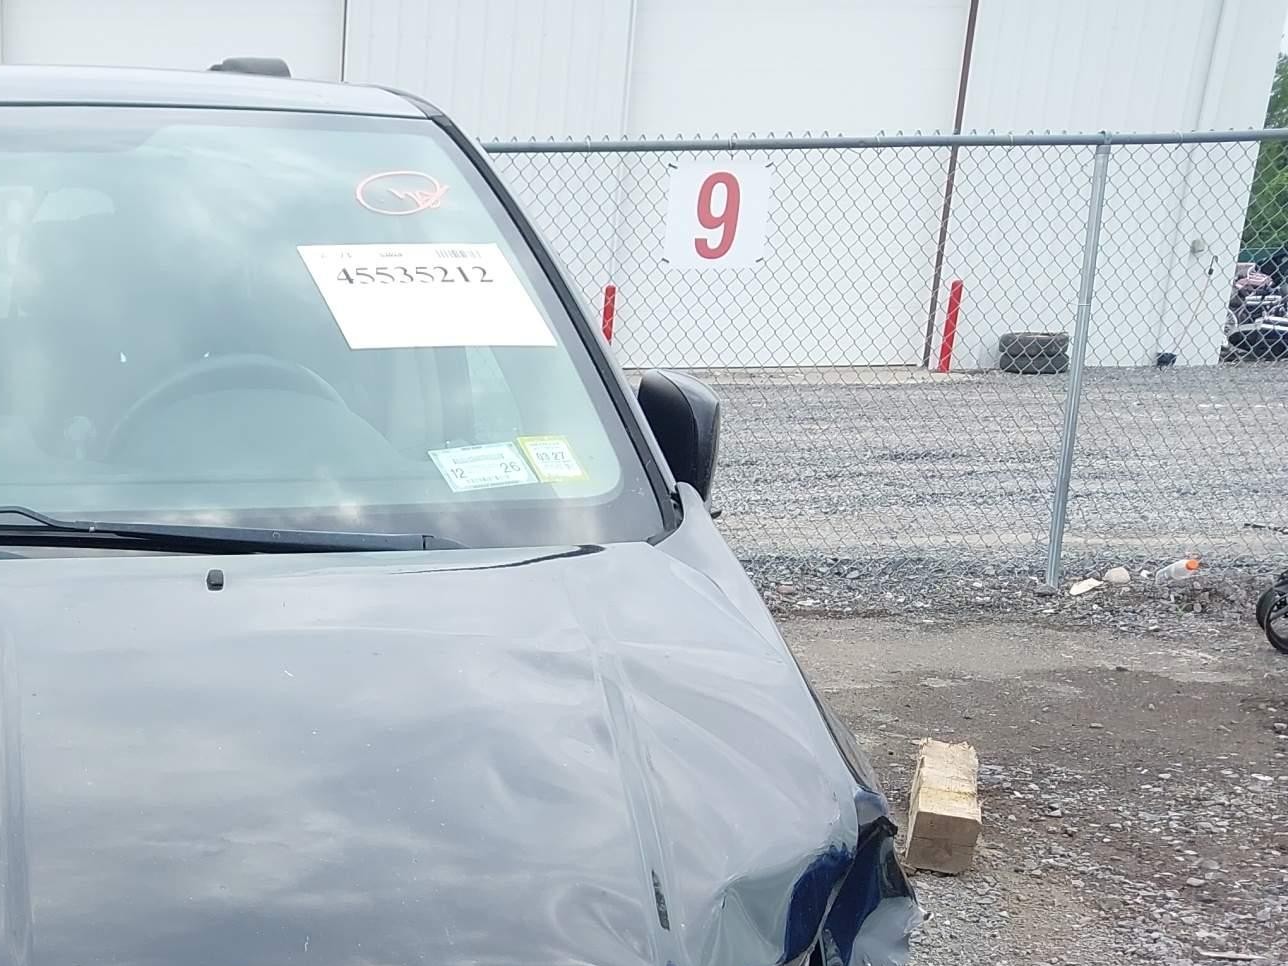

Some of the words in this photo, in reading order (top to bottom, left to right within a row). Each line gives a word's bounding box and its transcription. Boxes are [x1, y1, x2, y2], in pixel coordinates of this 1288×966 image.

[694, 171, 741, 260] 9
[336, 266, 494, 285] 45535212
[450, 467, 468, 479] 12
[499, 461, 521, 474] 26
